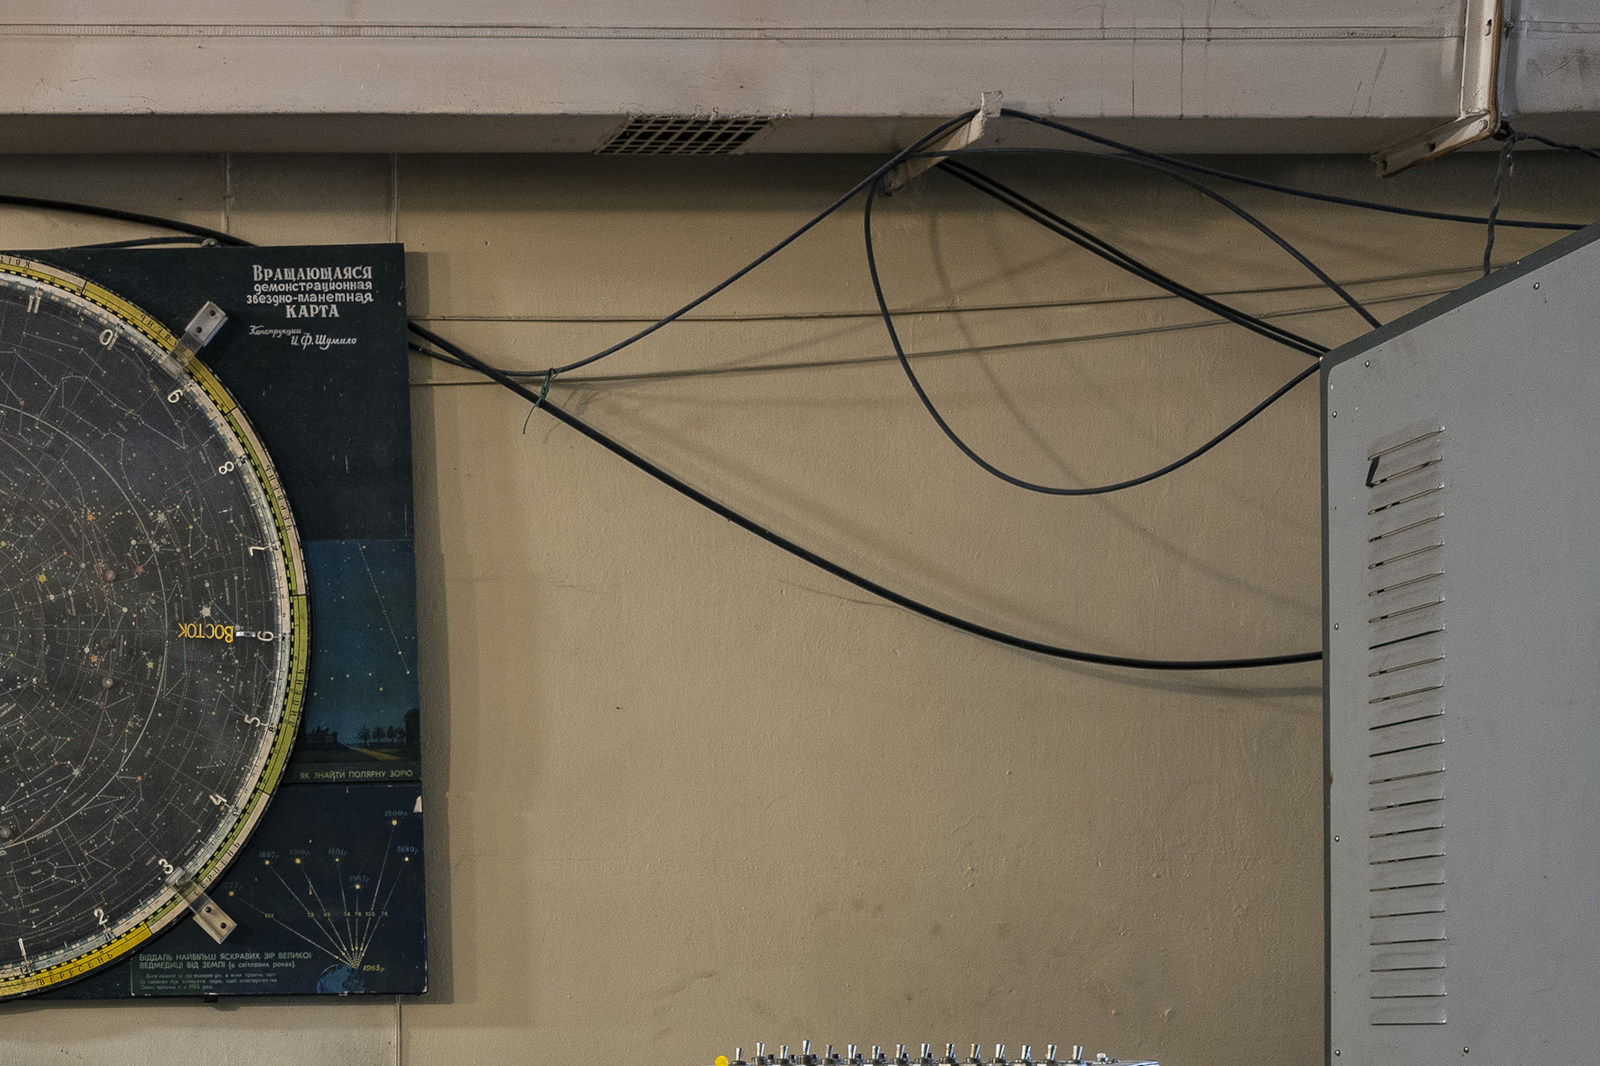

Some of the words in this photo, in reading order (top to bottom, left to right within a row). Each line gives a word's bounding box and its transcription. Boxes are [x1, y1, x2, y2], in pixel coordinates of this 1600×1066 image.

[253, 280, 373, 295] демонстрационная
[27, 295, 41, 314] 11
[246, 292, 374, 306] звездно-планетная
[285, 304, 340, 318] КАРТА
[248, 325, 302, 339] Конструкции
[99, 329, 118, 350] 10
[218, 461, 234, 475] 8
[178, 622, 234, 643] Восток
[244, 713, 261, 727] 5
[313, 771, 345, 779] ЗНАЙТИ
[348, 770, 386, 778] ПОЛЯРНУ
[389, 769, 414, 777] ЗОРЮ
[209, 793, 227, 807] 4
[158, 857, 174, 874] 3
[93, 909, 108, 926] 2
[219, 952, 261, 961] ЯСКРАВИХ
